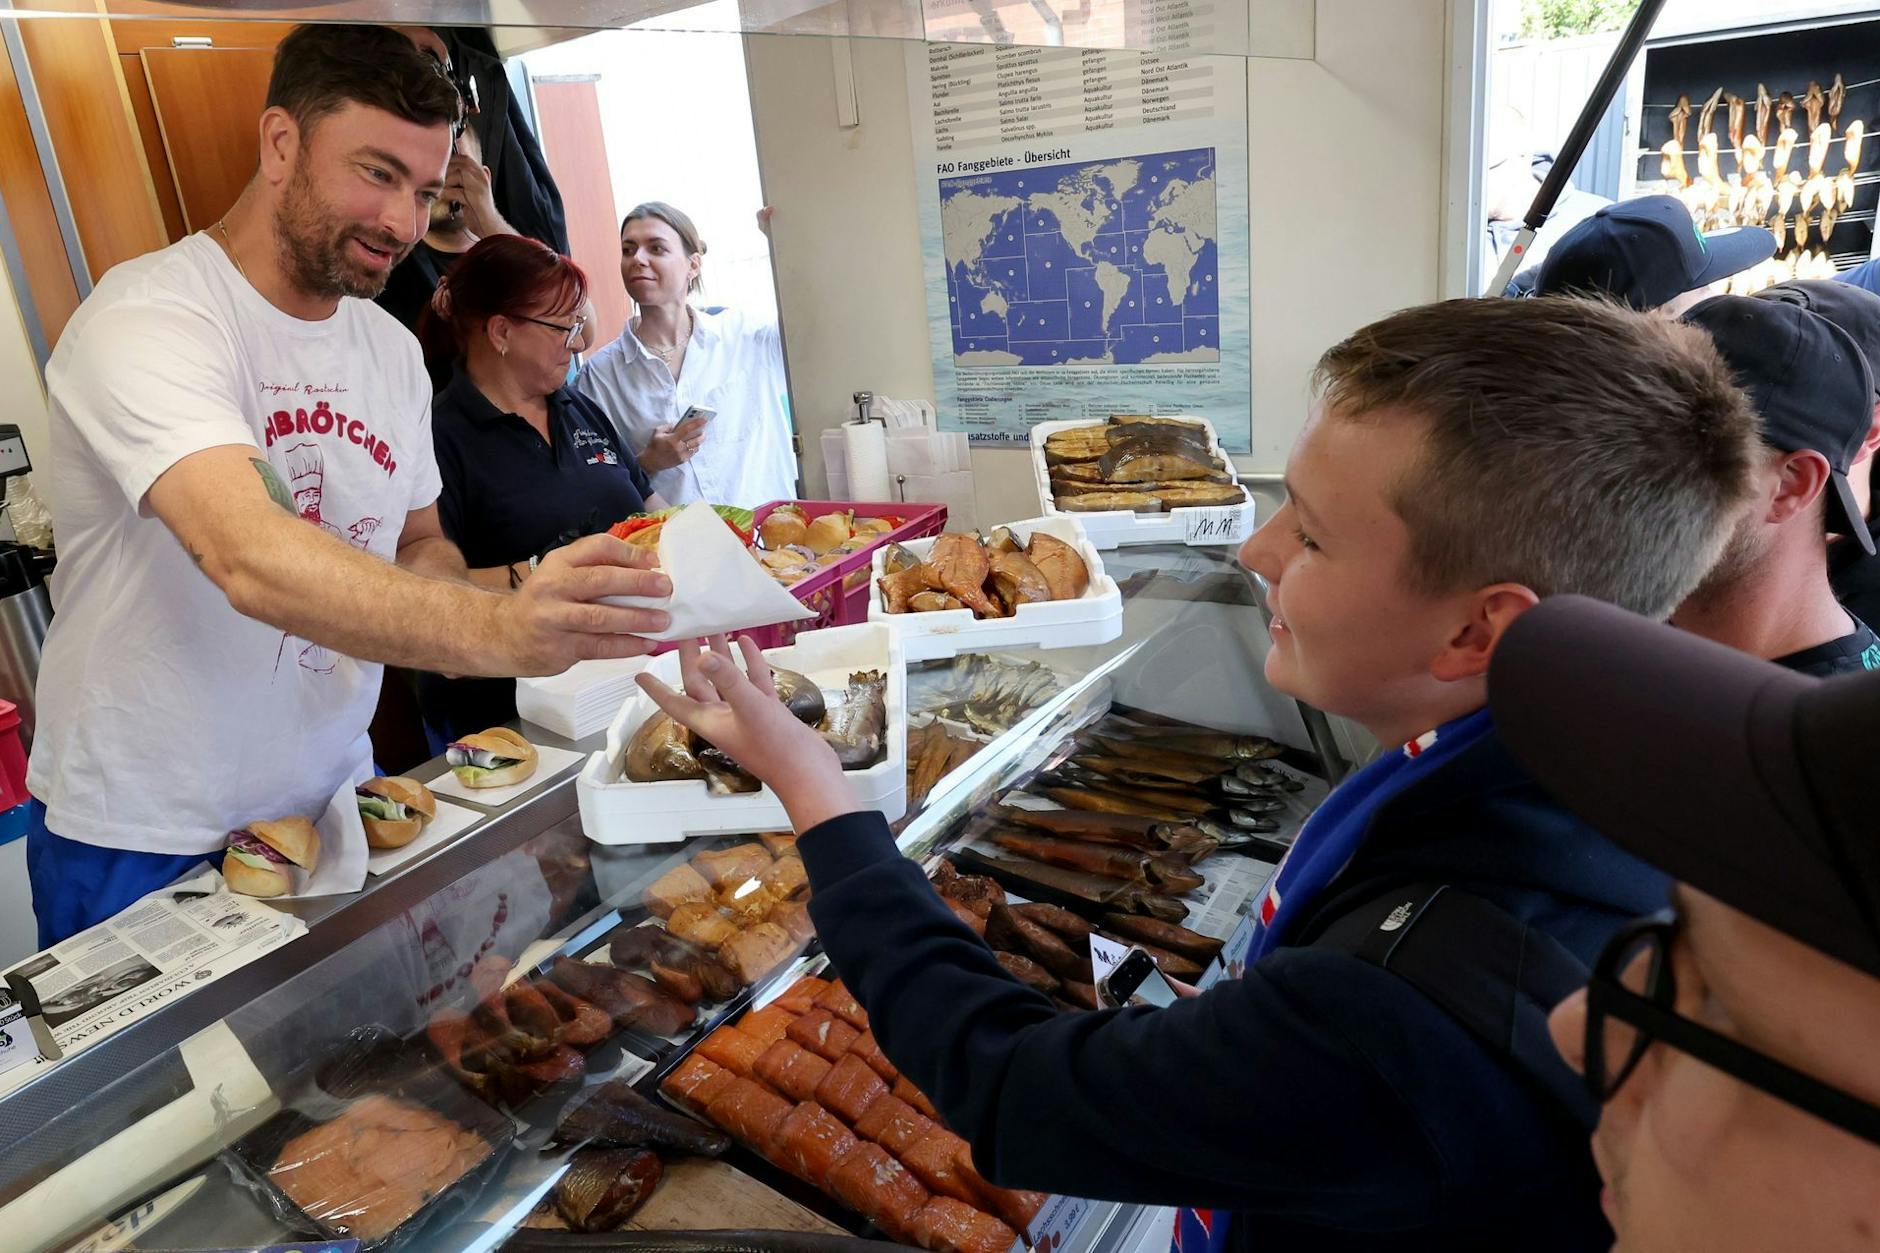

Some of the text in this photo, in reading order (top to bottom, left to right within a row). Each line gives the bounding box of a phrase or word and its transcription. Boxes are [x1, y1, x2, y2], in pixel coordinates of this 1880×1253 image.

[1166, 2, 1189, 10] Atlantik
[1171, 11, 1194, 20] Atlantik
[1167, 22, 1190, 30] Atlantik
[1082, 56, 1106, 66] gefangen
[1082, 66, 1107, 76] gefangen
[1166, 62, 1188, 71] Atlantik
[1141, 76, 1168, 85] Dänemark
[1083, 84, 1112, 94] Aquakultur
[1142, 85, 1169, 94] Dänemark
[1084, 94, 1112, 104] Aquakultur
[1142, 96, 1170, 104] Norwegen
[1084, 104, 1114, 113] Aquakultur
[1142, 104, 1176, 114] Deutschland
[1084, 113, 1114, 122] Aquakultur
[1142, 115, 1170, 124] Dänemark
[1085, 123, 1114, 132] Aquakultur
[937, 163, 954, 174] FAO
[958, 157, 1013, 172] Fanggebiete
[1024, 148, 1071, 163] Übersicht
[1013, 432, 1029, 442] und
[119, 980, 192, 1016] WORLD
